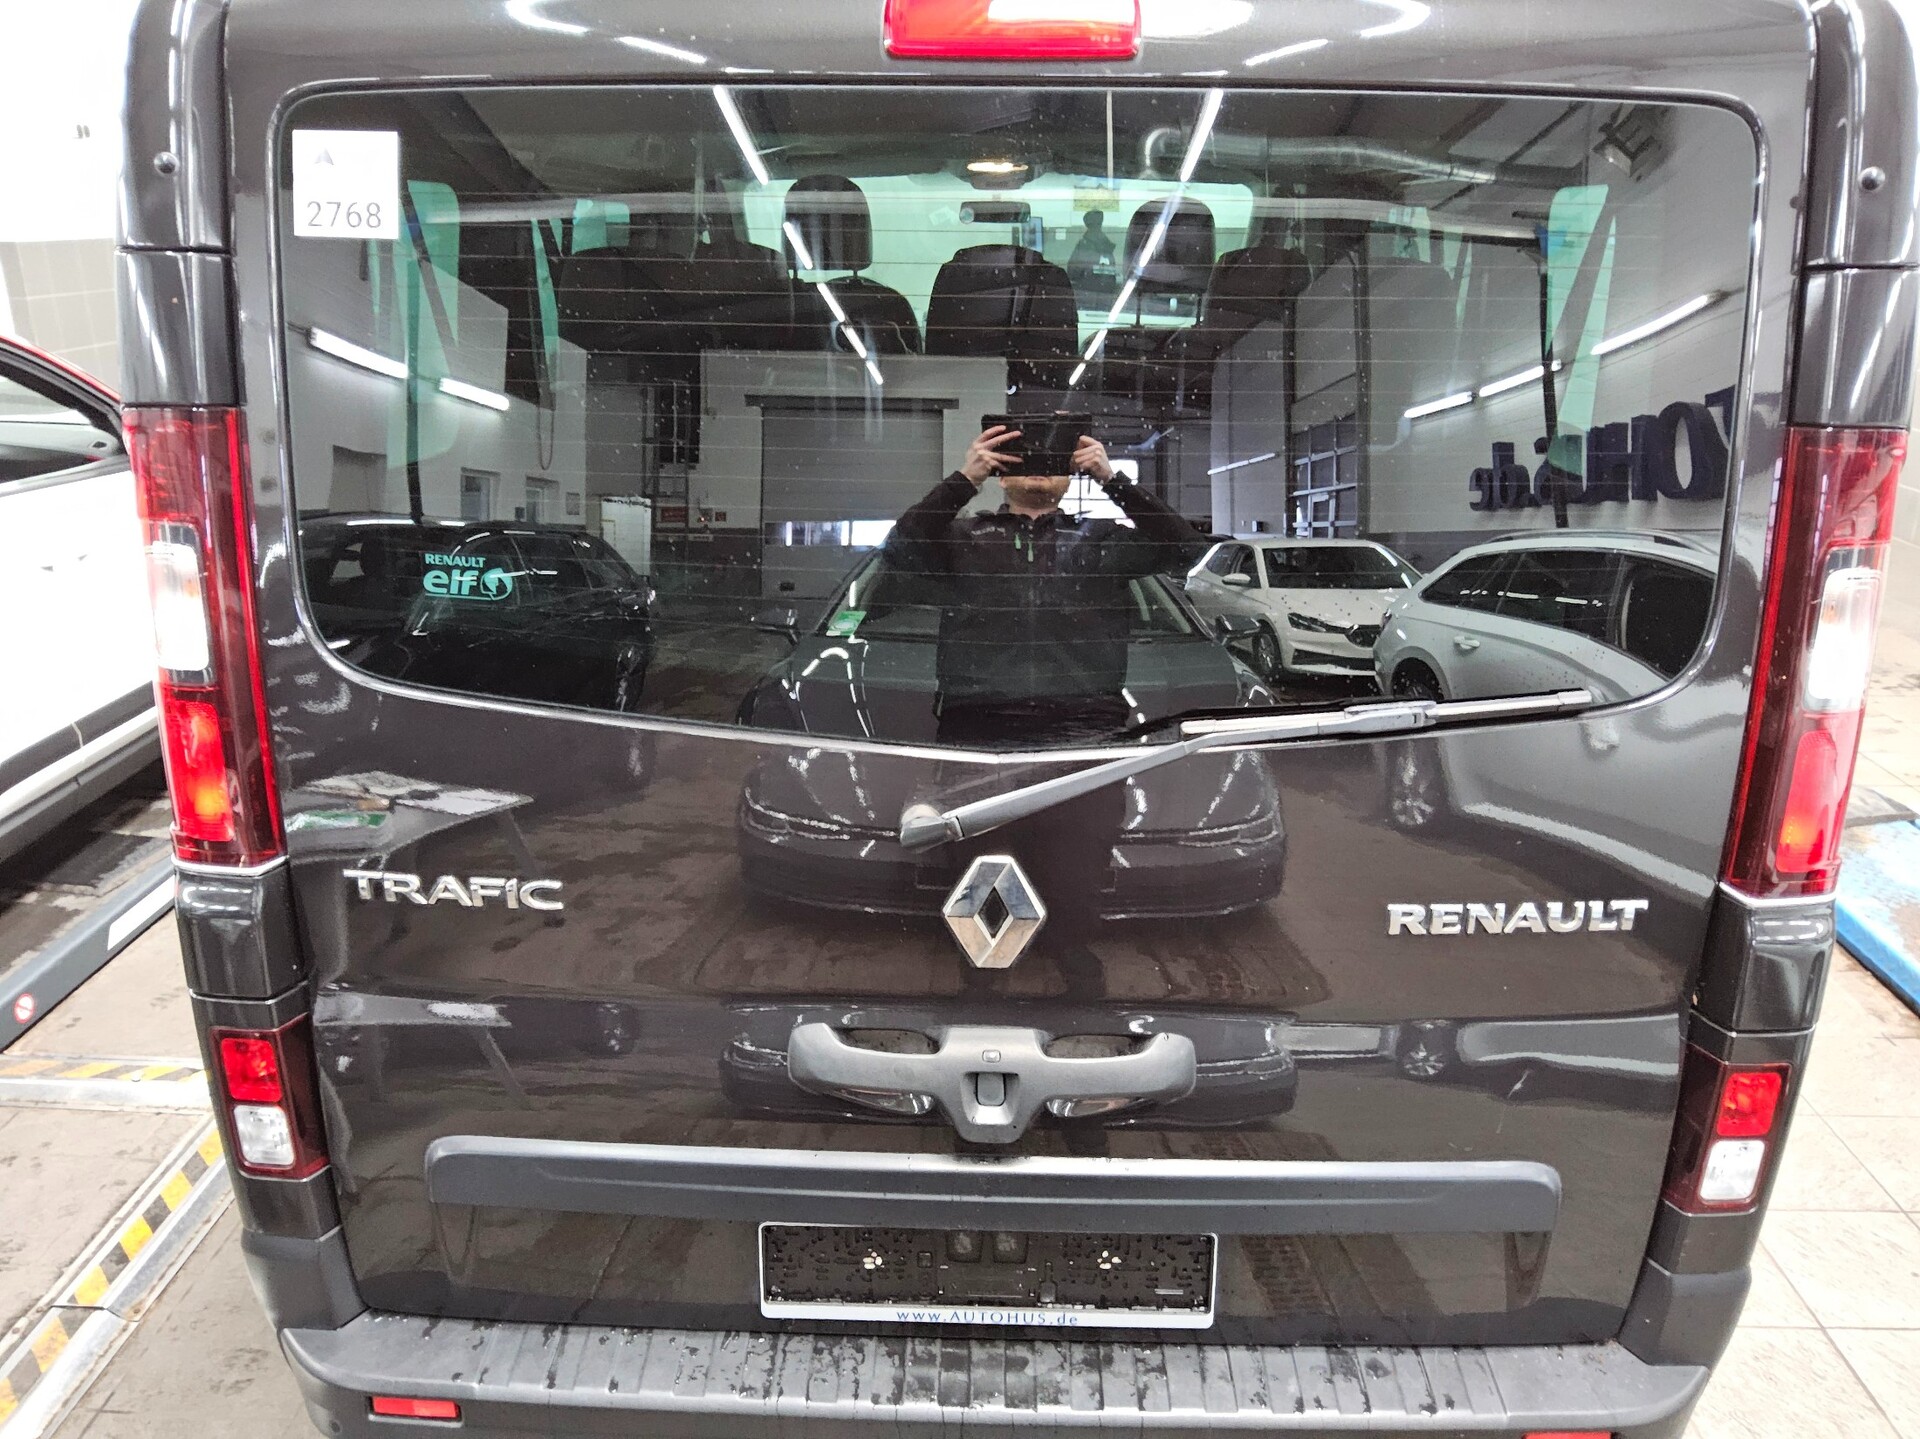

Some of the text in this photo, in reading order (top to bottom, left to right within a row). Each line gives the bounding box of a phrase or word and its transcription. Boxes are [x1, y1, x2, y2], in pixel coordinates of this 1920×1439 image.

[306, 201, 382, 228] 2768
[425, 553, 486, 568] RENAULT
[423, 569, 479, 595] elf
[343, 869, 564, 910] TRAFIC
[1387, 899, 1649, 935] RENAULT
[896, 1310, 1078, 1326] www.AUTOHUS.de
